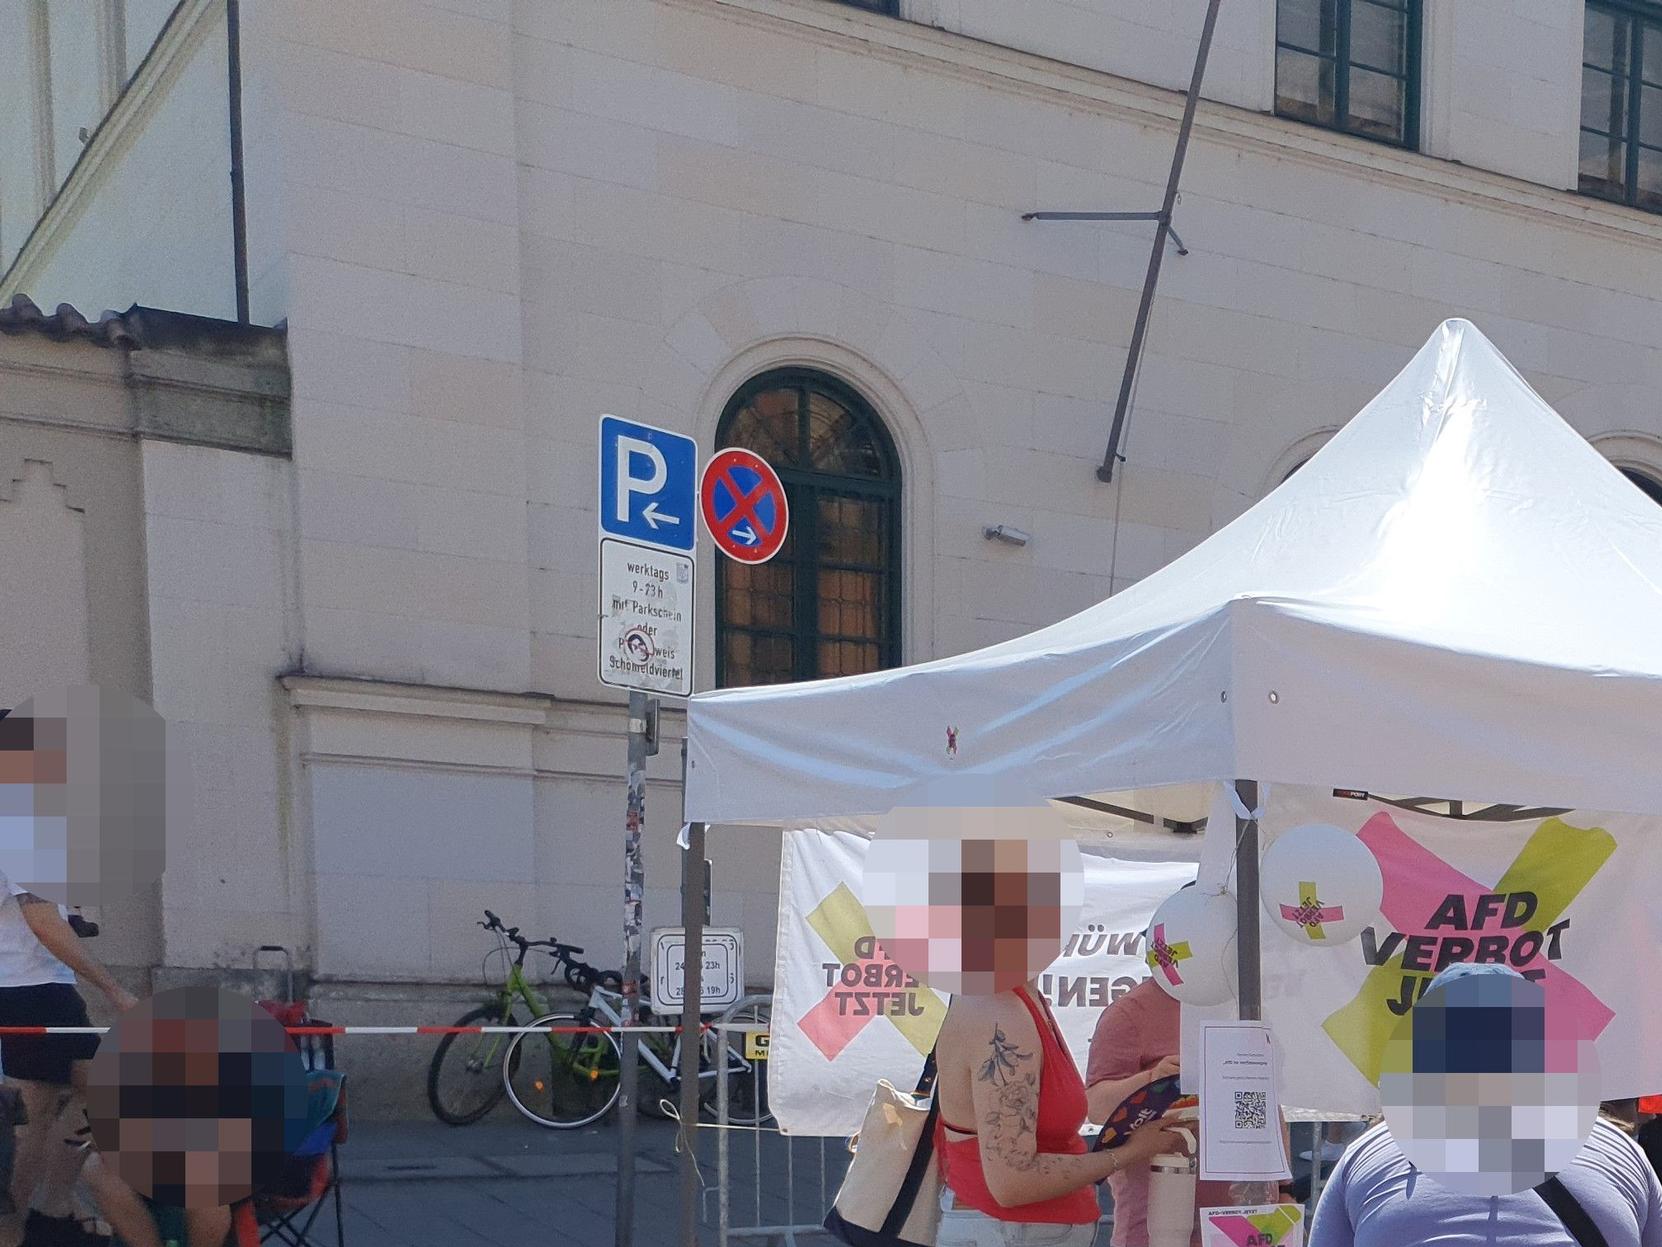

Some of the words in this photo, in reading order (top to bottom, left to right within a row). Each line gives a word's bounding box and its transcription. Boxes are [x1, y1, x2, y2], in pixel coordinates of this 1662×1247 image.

[617, 434, 668, 522] P
[626, 562, 669, 582] werktags
[1424, 891, 1538, 931] AFD
[1360, 918, 1571, 973] VERBOT
[1247, 1232, 1273, 1247] AFD
